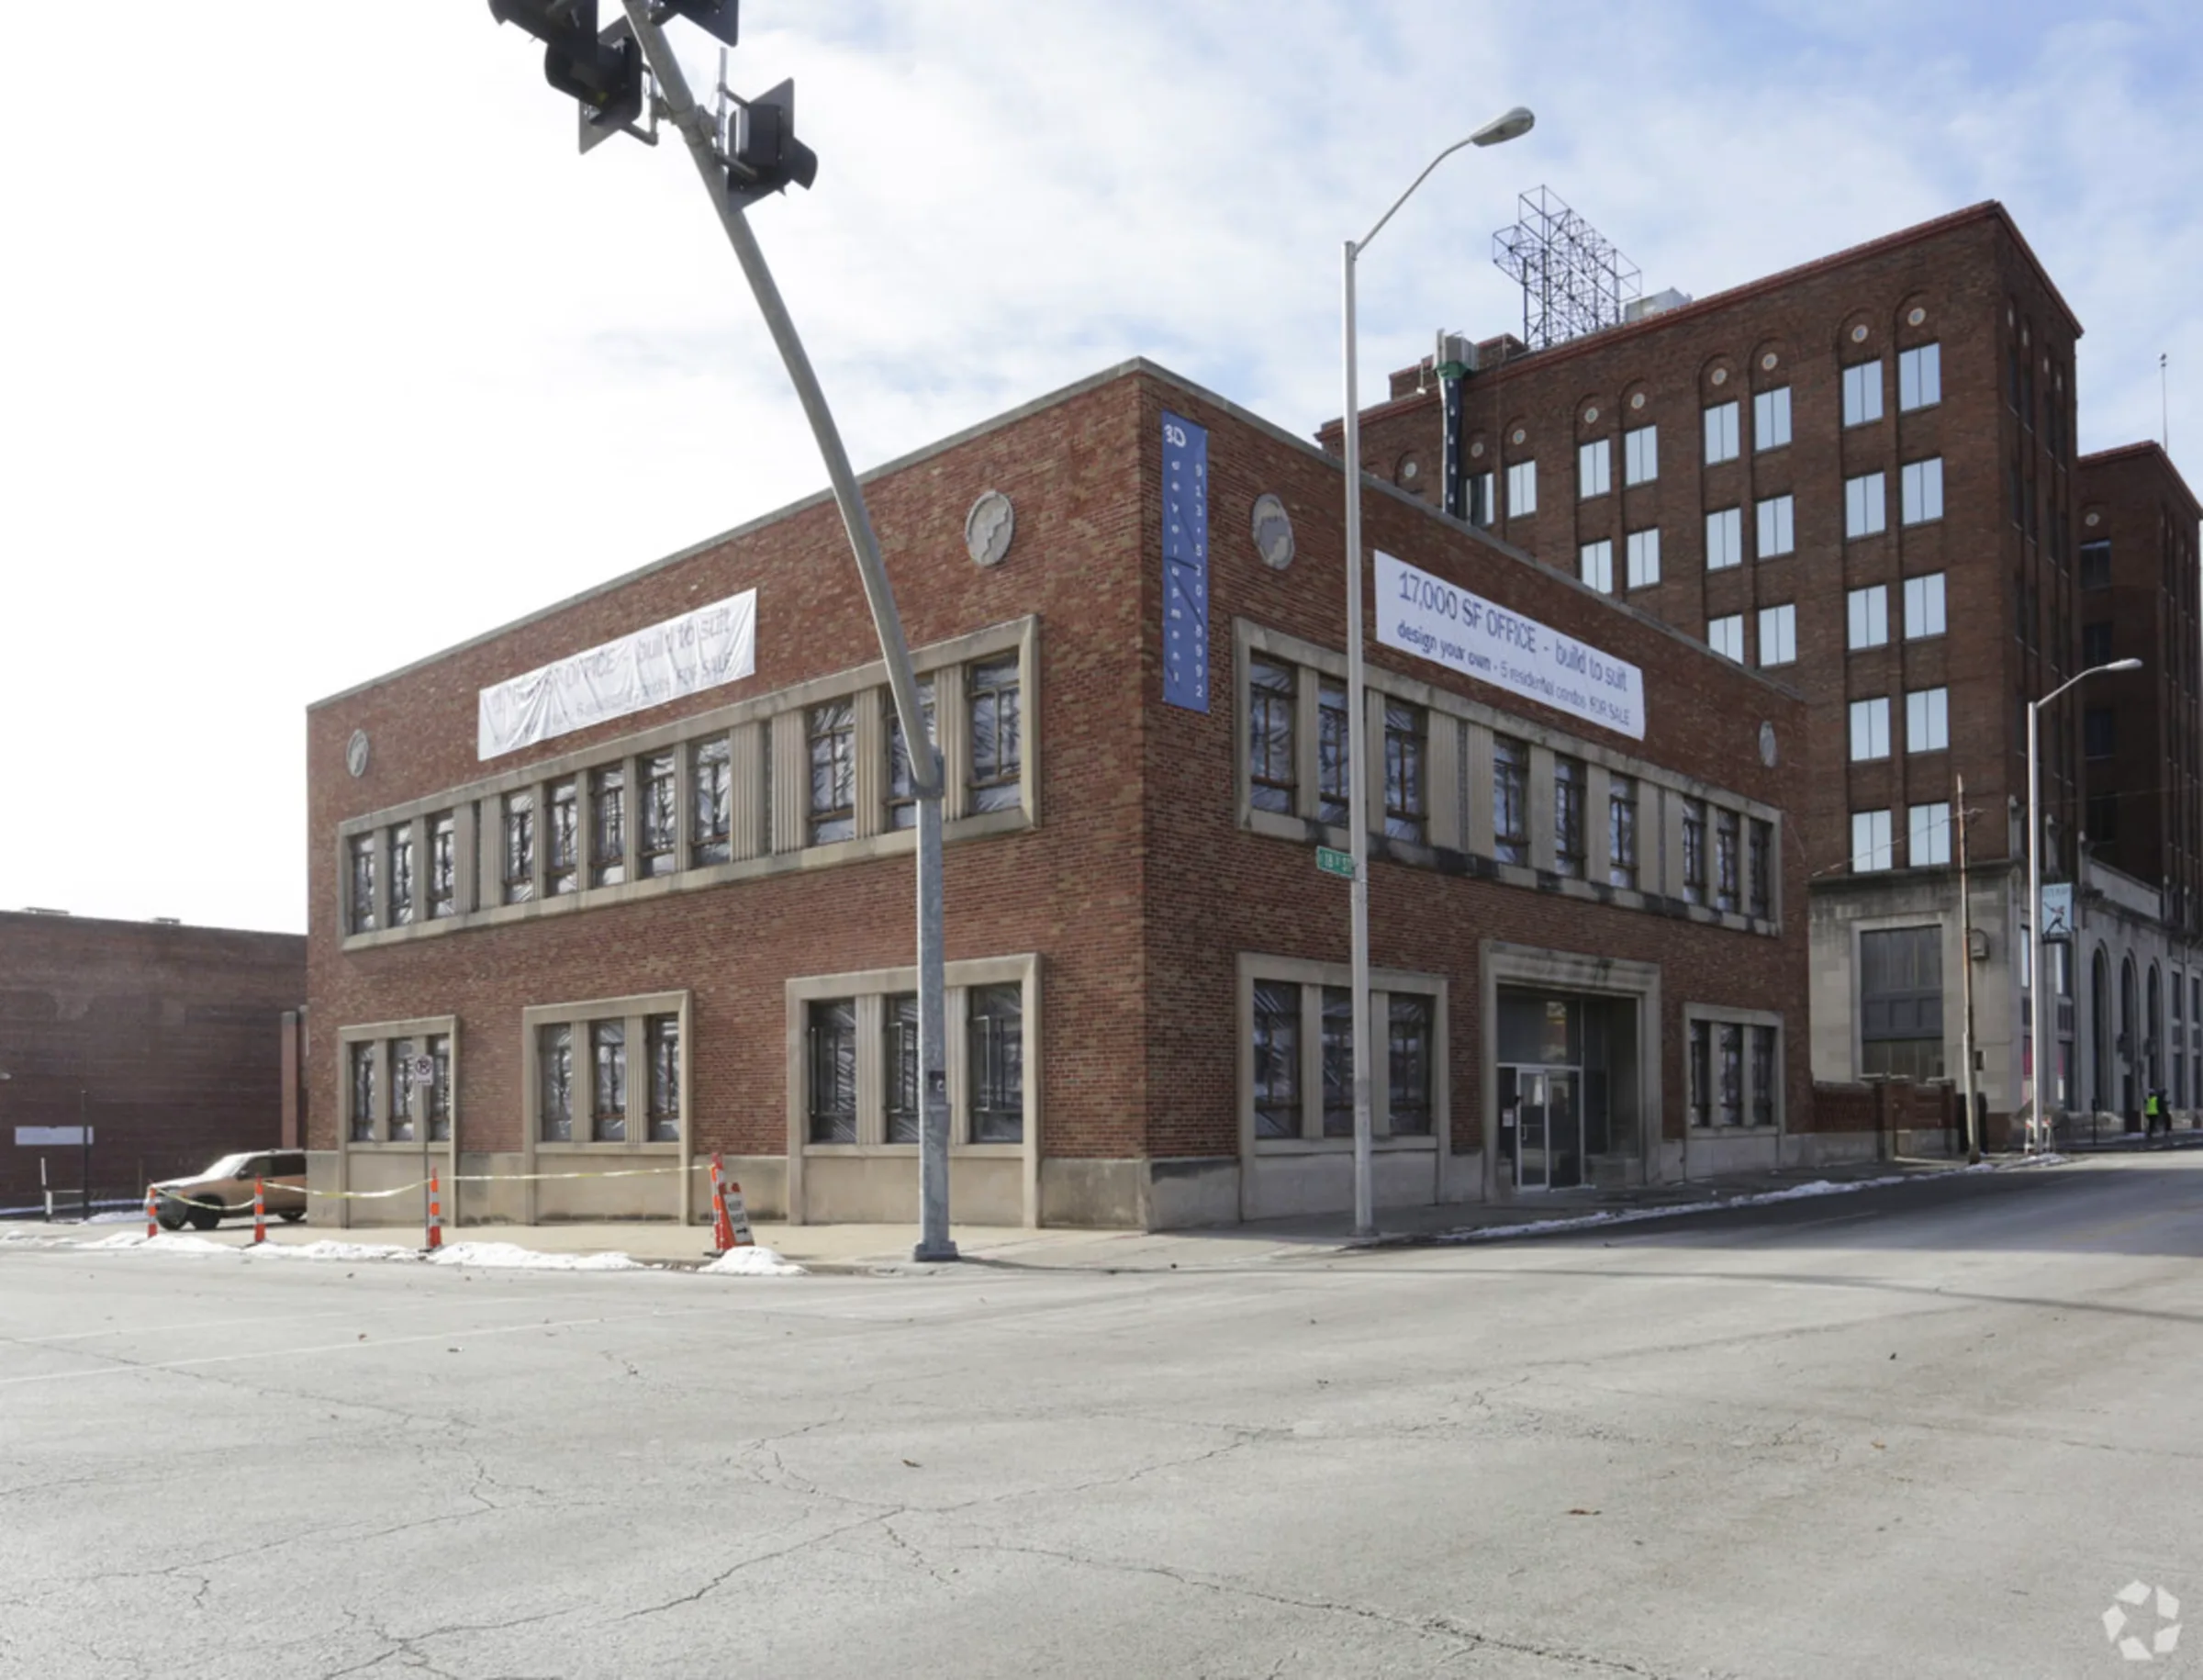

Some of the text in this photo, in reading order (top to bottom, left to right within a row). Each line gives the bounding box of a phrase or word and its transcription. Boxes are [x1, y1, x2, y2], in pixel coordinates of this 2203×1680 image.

[1397, 620, 1437, 654] design
[1440, 639, 1465, 659] your
[1469, 652, 1491, 671] own
[1501, 660, 1507, 678] 5
[1510, 667, 1554, 696] residential
[1609, 702, 1630, 725] SALE
[1399, 571, 1457, 620] 17,000
[1462, 599, 1482, 629] SF
[1487, 609, 1537, 653] OFFICE
[1556, 639, 1586, 674] build
[1590, 655, 1603, 681] to
